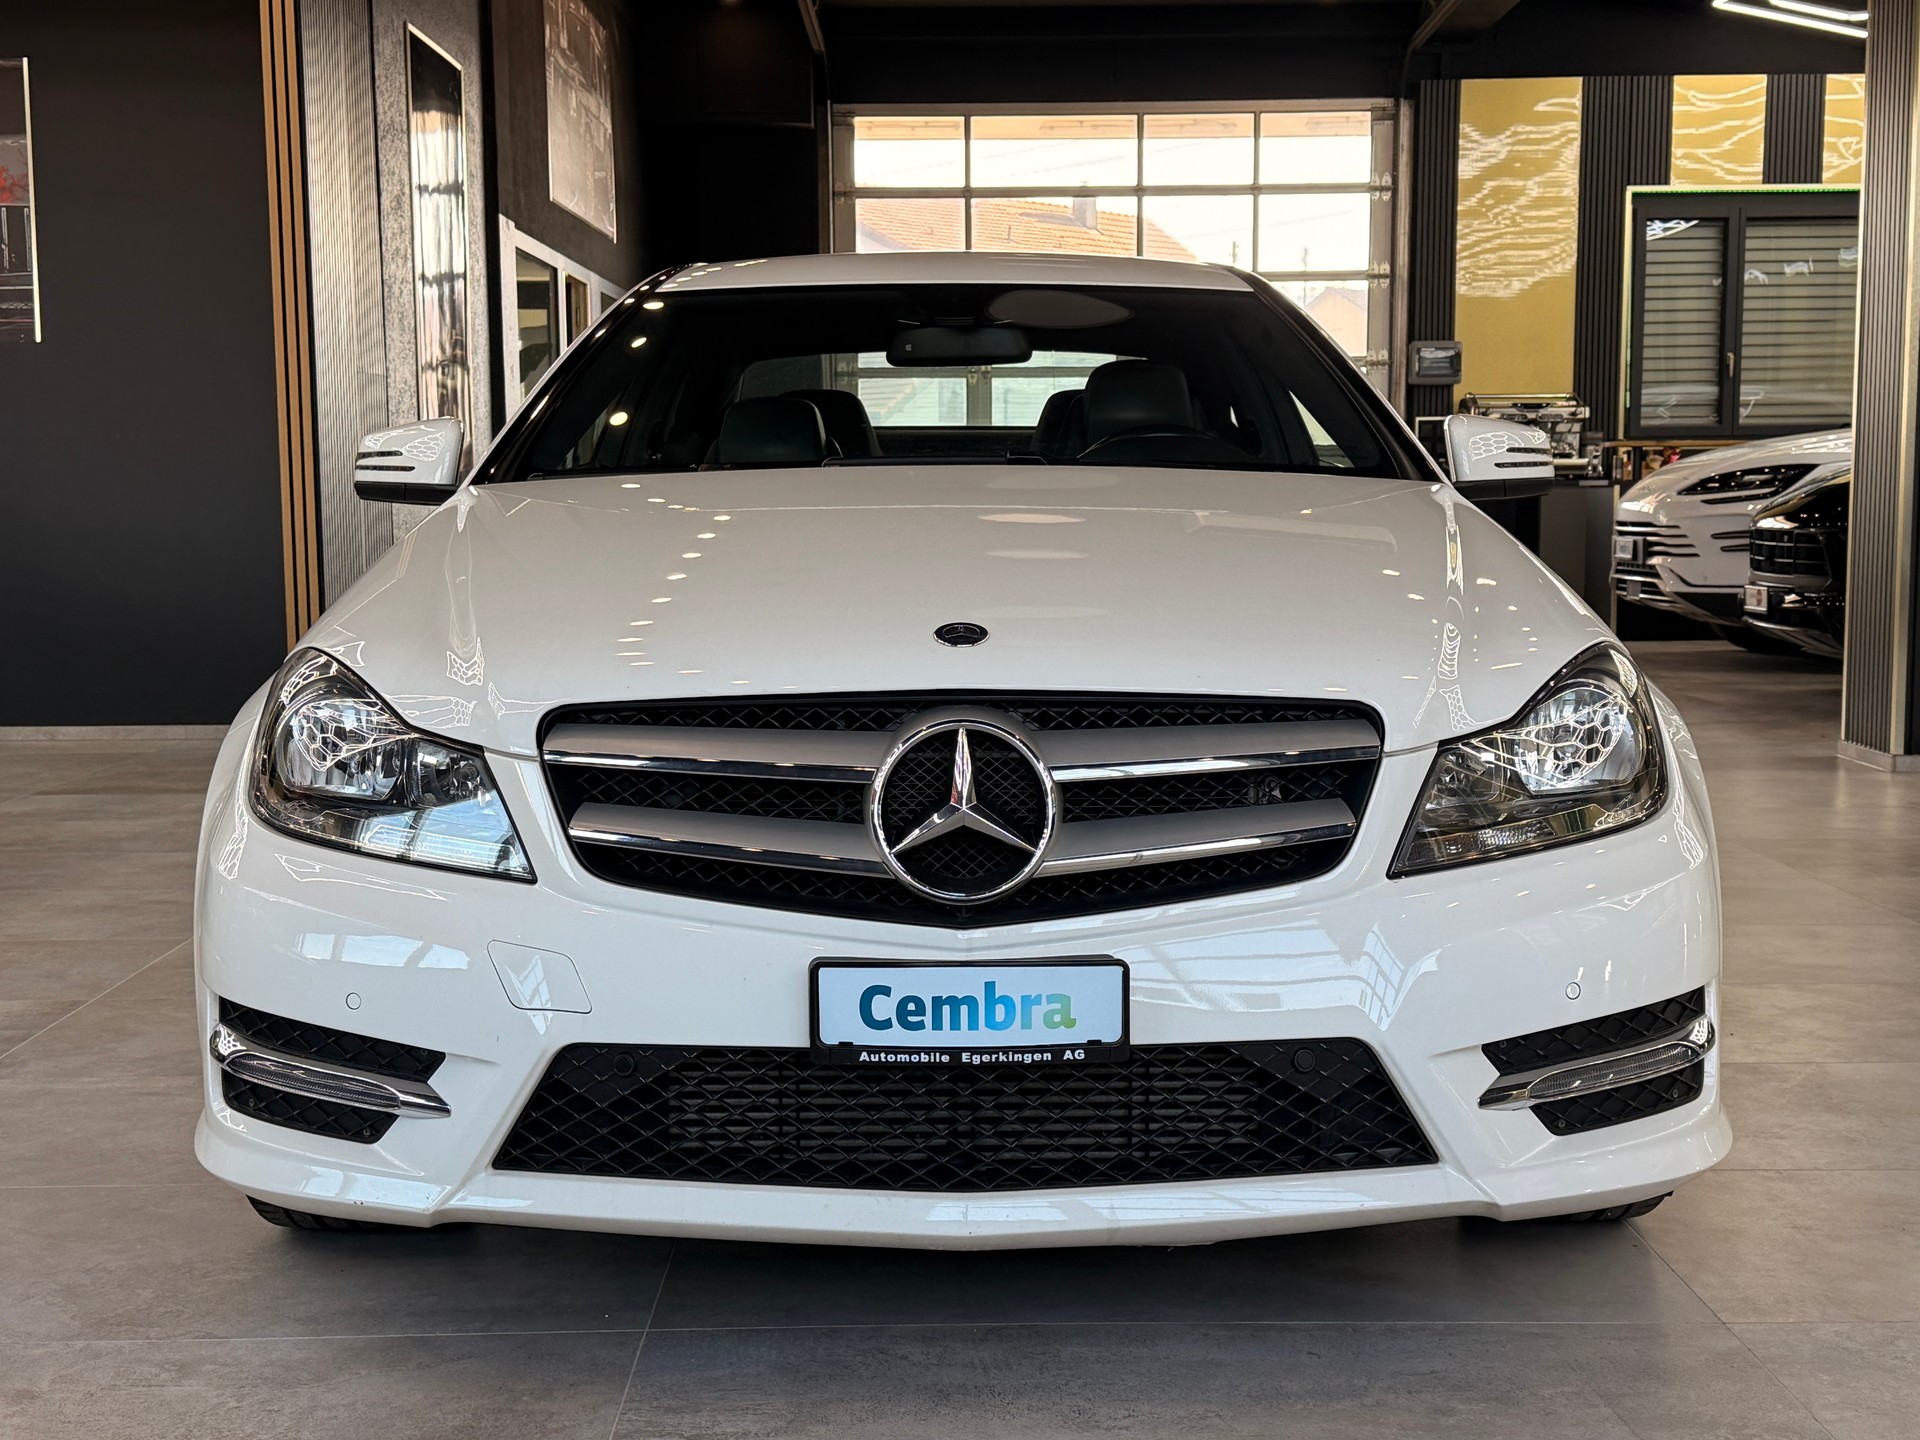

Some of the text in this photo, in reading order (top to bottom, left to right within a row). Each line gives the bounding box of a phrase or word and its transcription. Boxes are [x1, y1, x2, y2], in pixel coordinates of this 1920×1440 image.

[859, 981, 1077, 1032] Cembra
[859, 1049, 1086, 1065] Automobile Egerkingen AG
